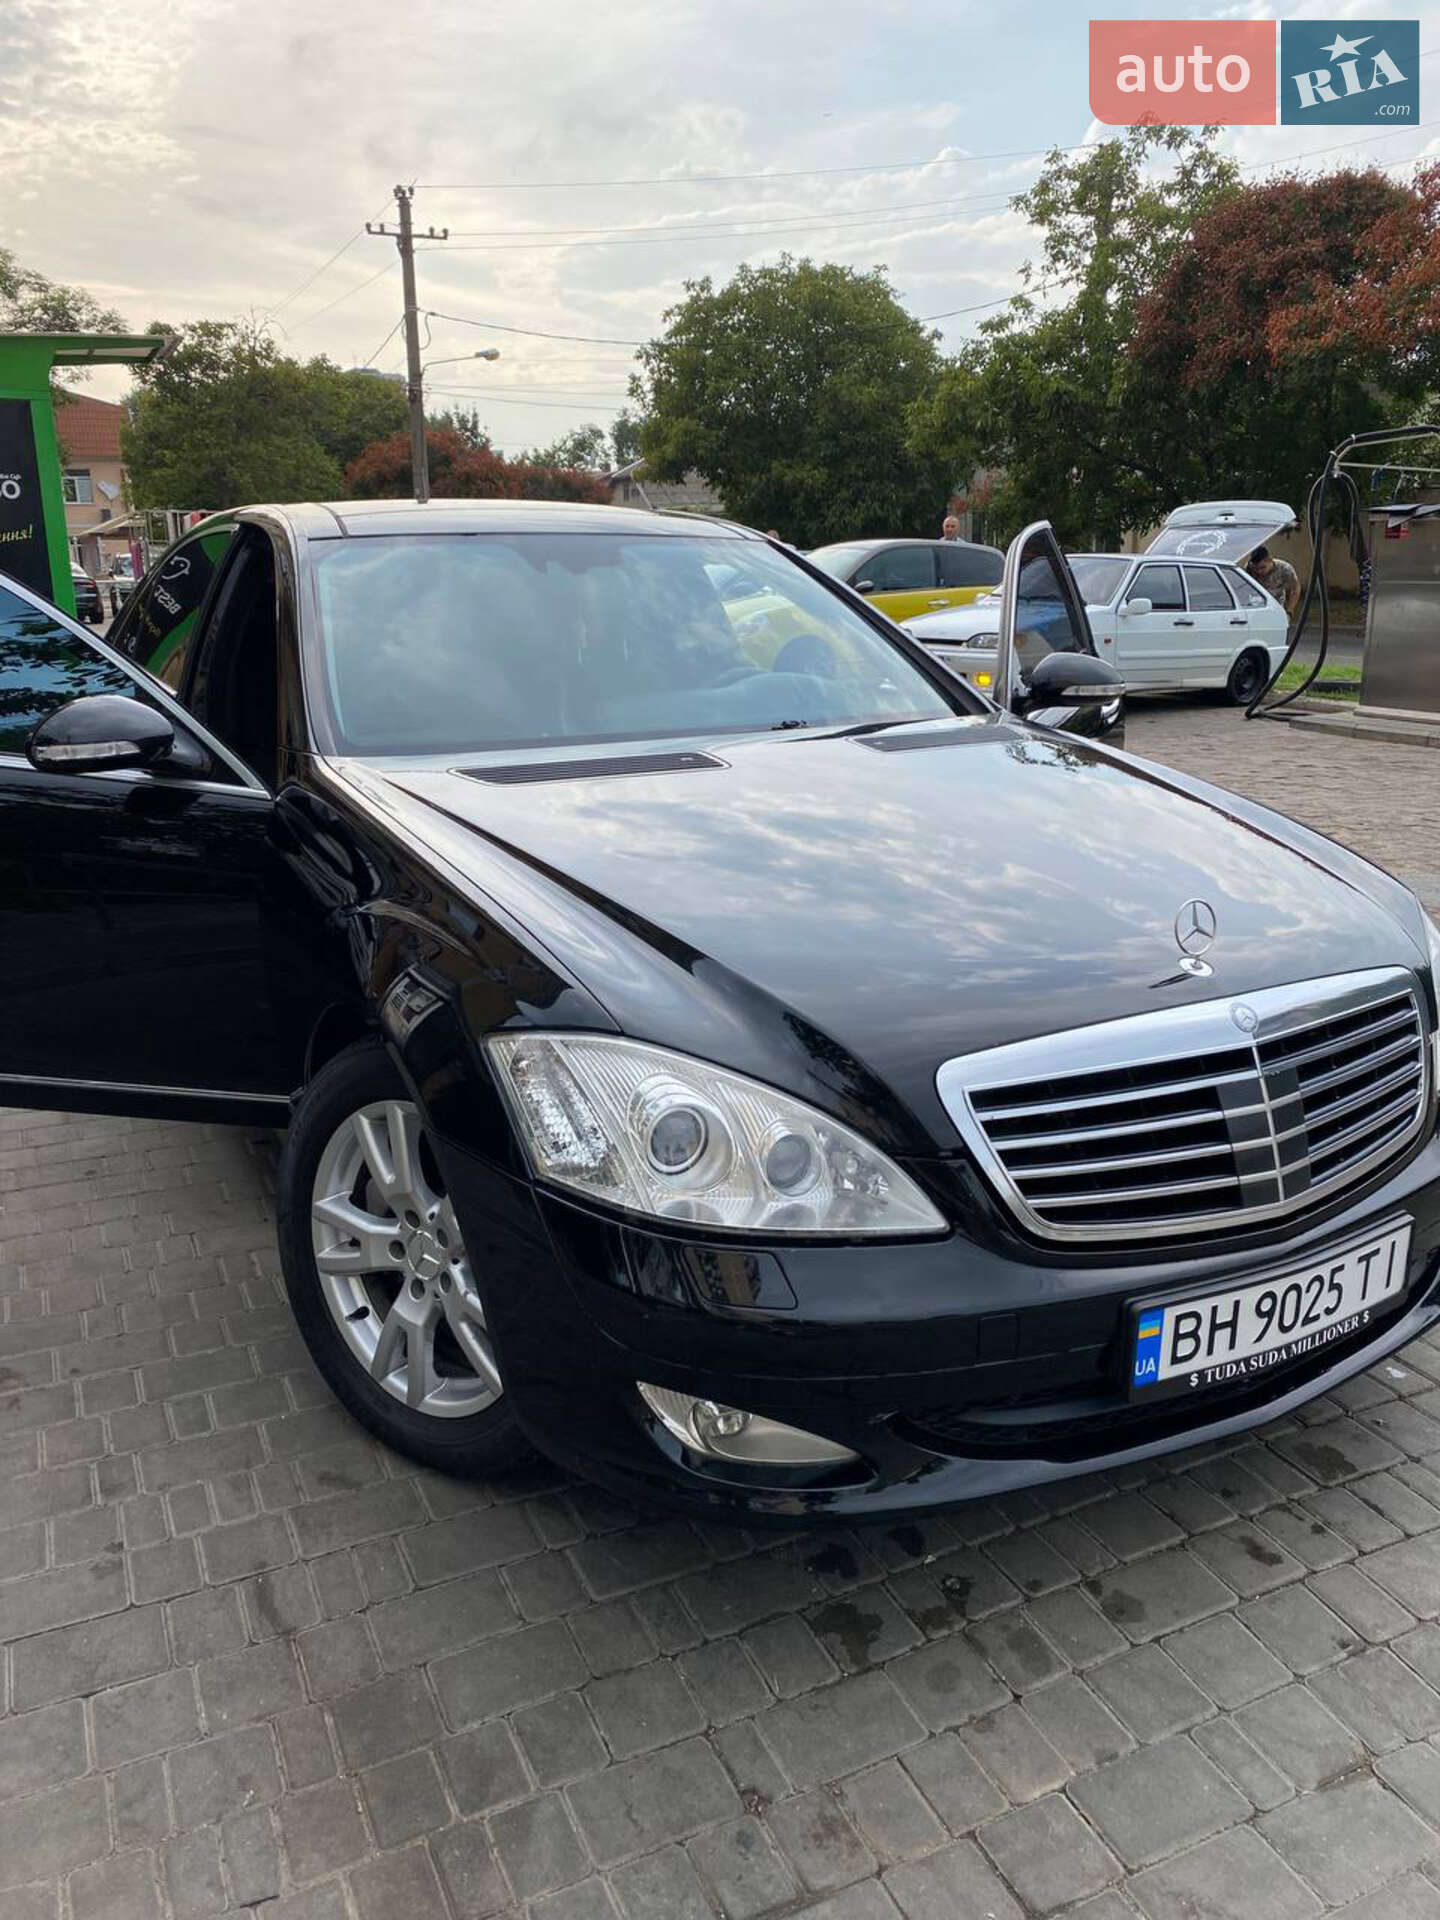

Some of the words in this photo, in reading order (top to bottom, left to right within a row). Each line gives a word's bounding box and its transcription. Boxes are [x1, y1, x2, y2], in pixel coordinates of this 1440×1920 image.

[1170, 1299, 1241, 1366] BH
[1252, 1264, 1345, 1345] 9025
[1357, 1240, 1397, 1301] TI
[1135, 1358, 1156, 1377] UA
[1203, 1360, 1248, 1384] TUDA
[1249, 1345, 1288, 1370] SUDA
[1289, 1315, 1359, 1358] MILLIONER
